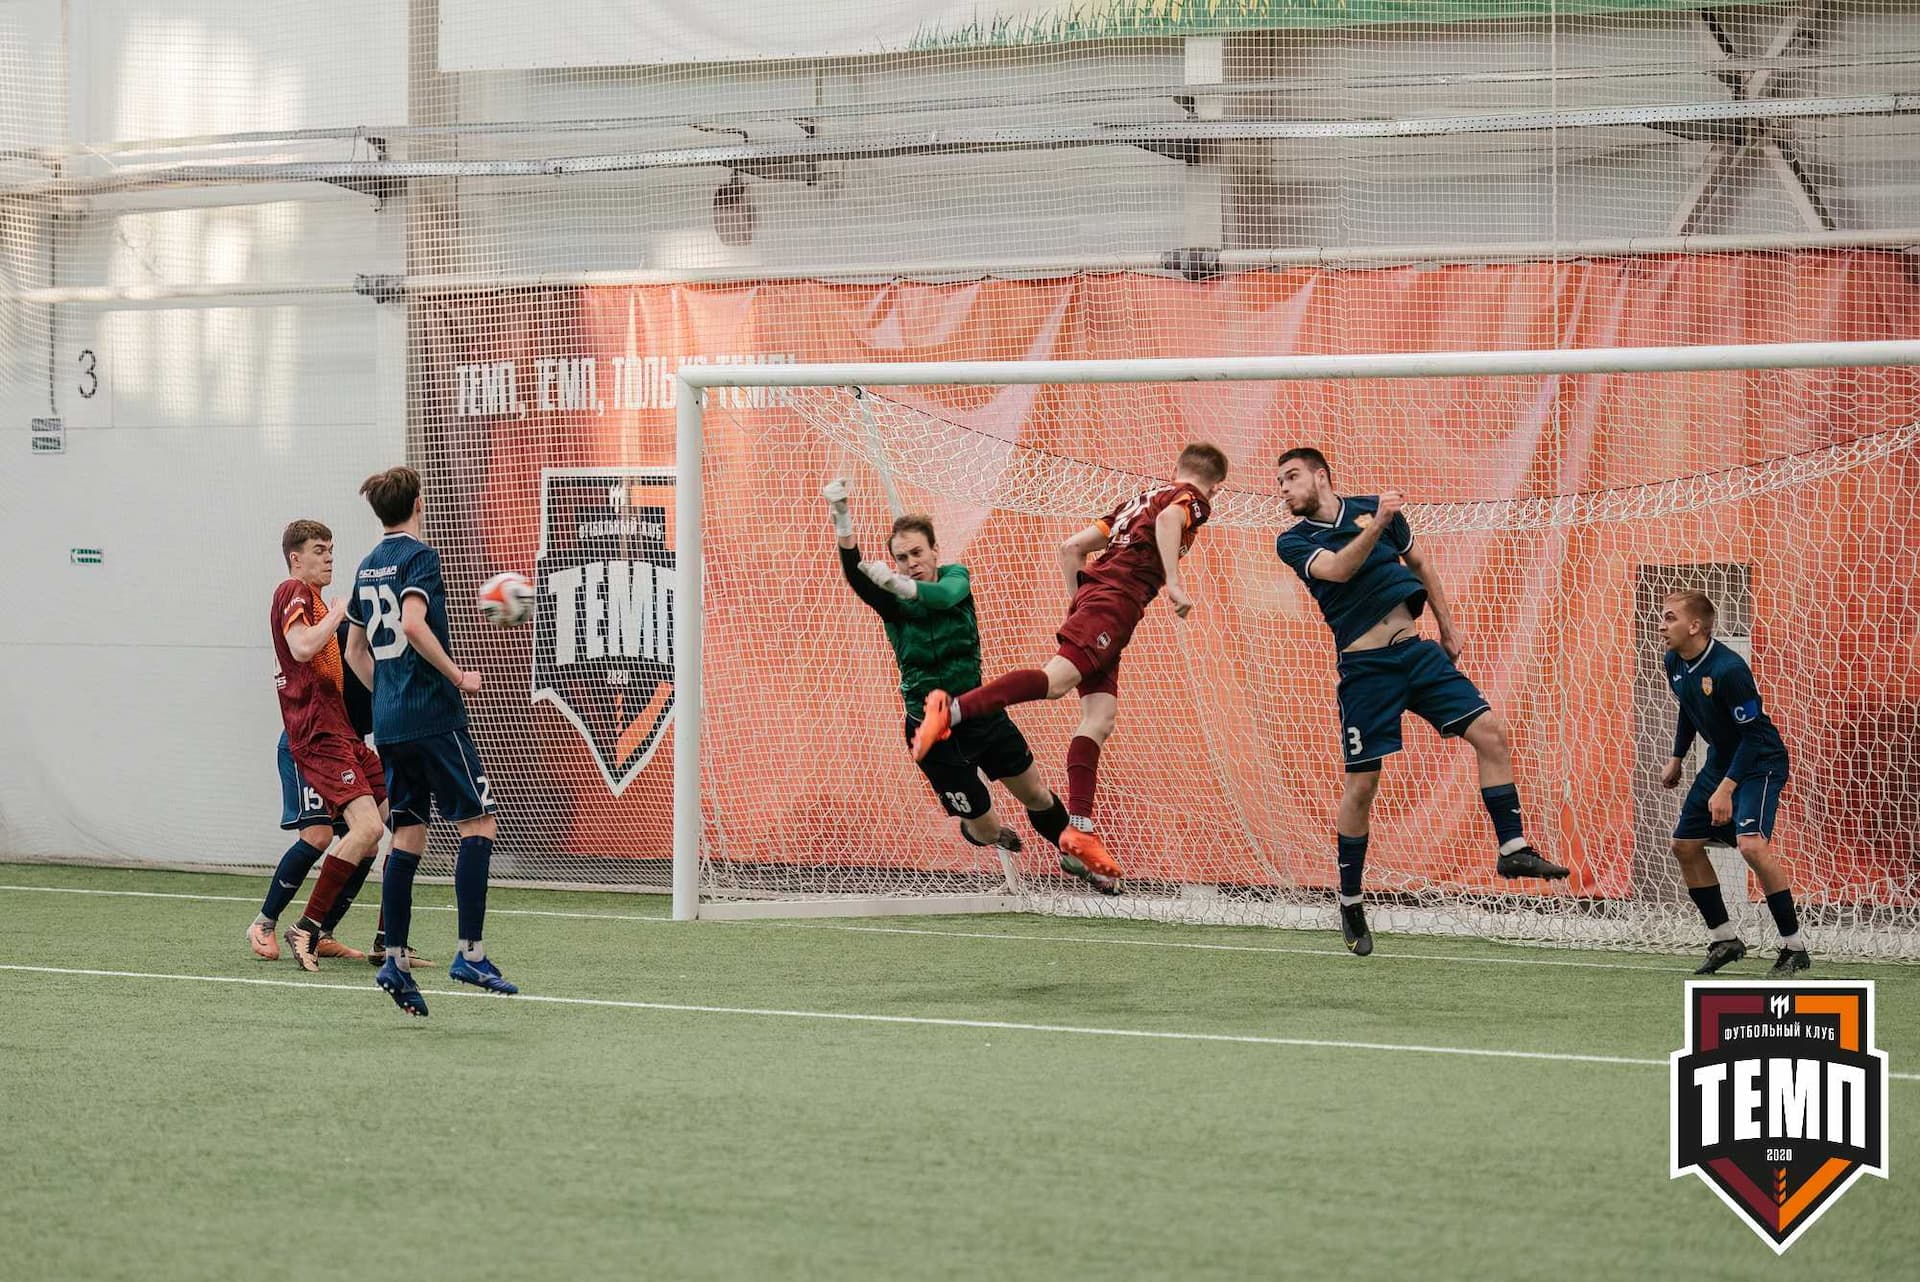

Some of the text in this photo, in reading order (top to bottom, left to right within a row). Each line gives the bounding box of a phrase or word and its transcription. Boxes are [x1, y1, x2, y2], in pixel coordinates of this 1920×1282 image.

[78, 349, 98, 399] 3
[536, 357, 604, 417] ТЕМП,
[359, 584, 408, 660] 23
[1347, 726, 1363, 756] 3
[945, 791, 972, 813] 33
